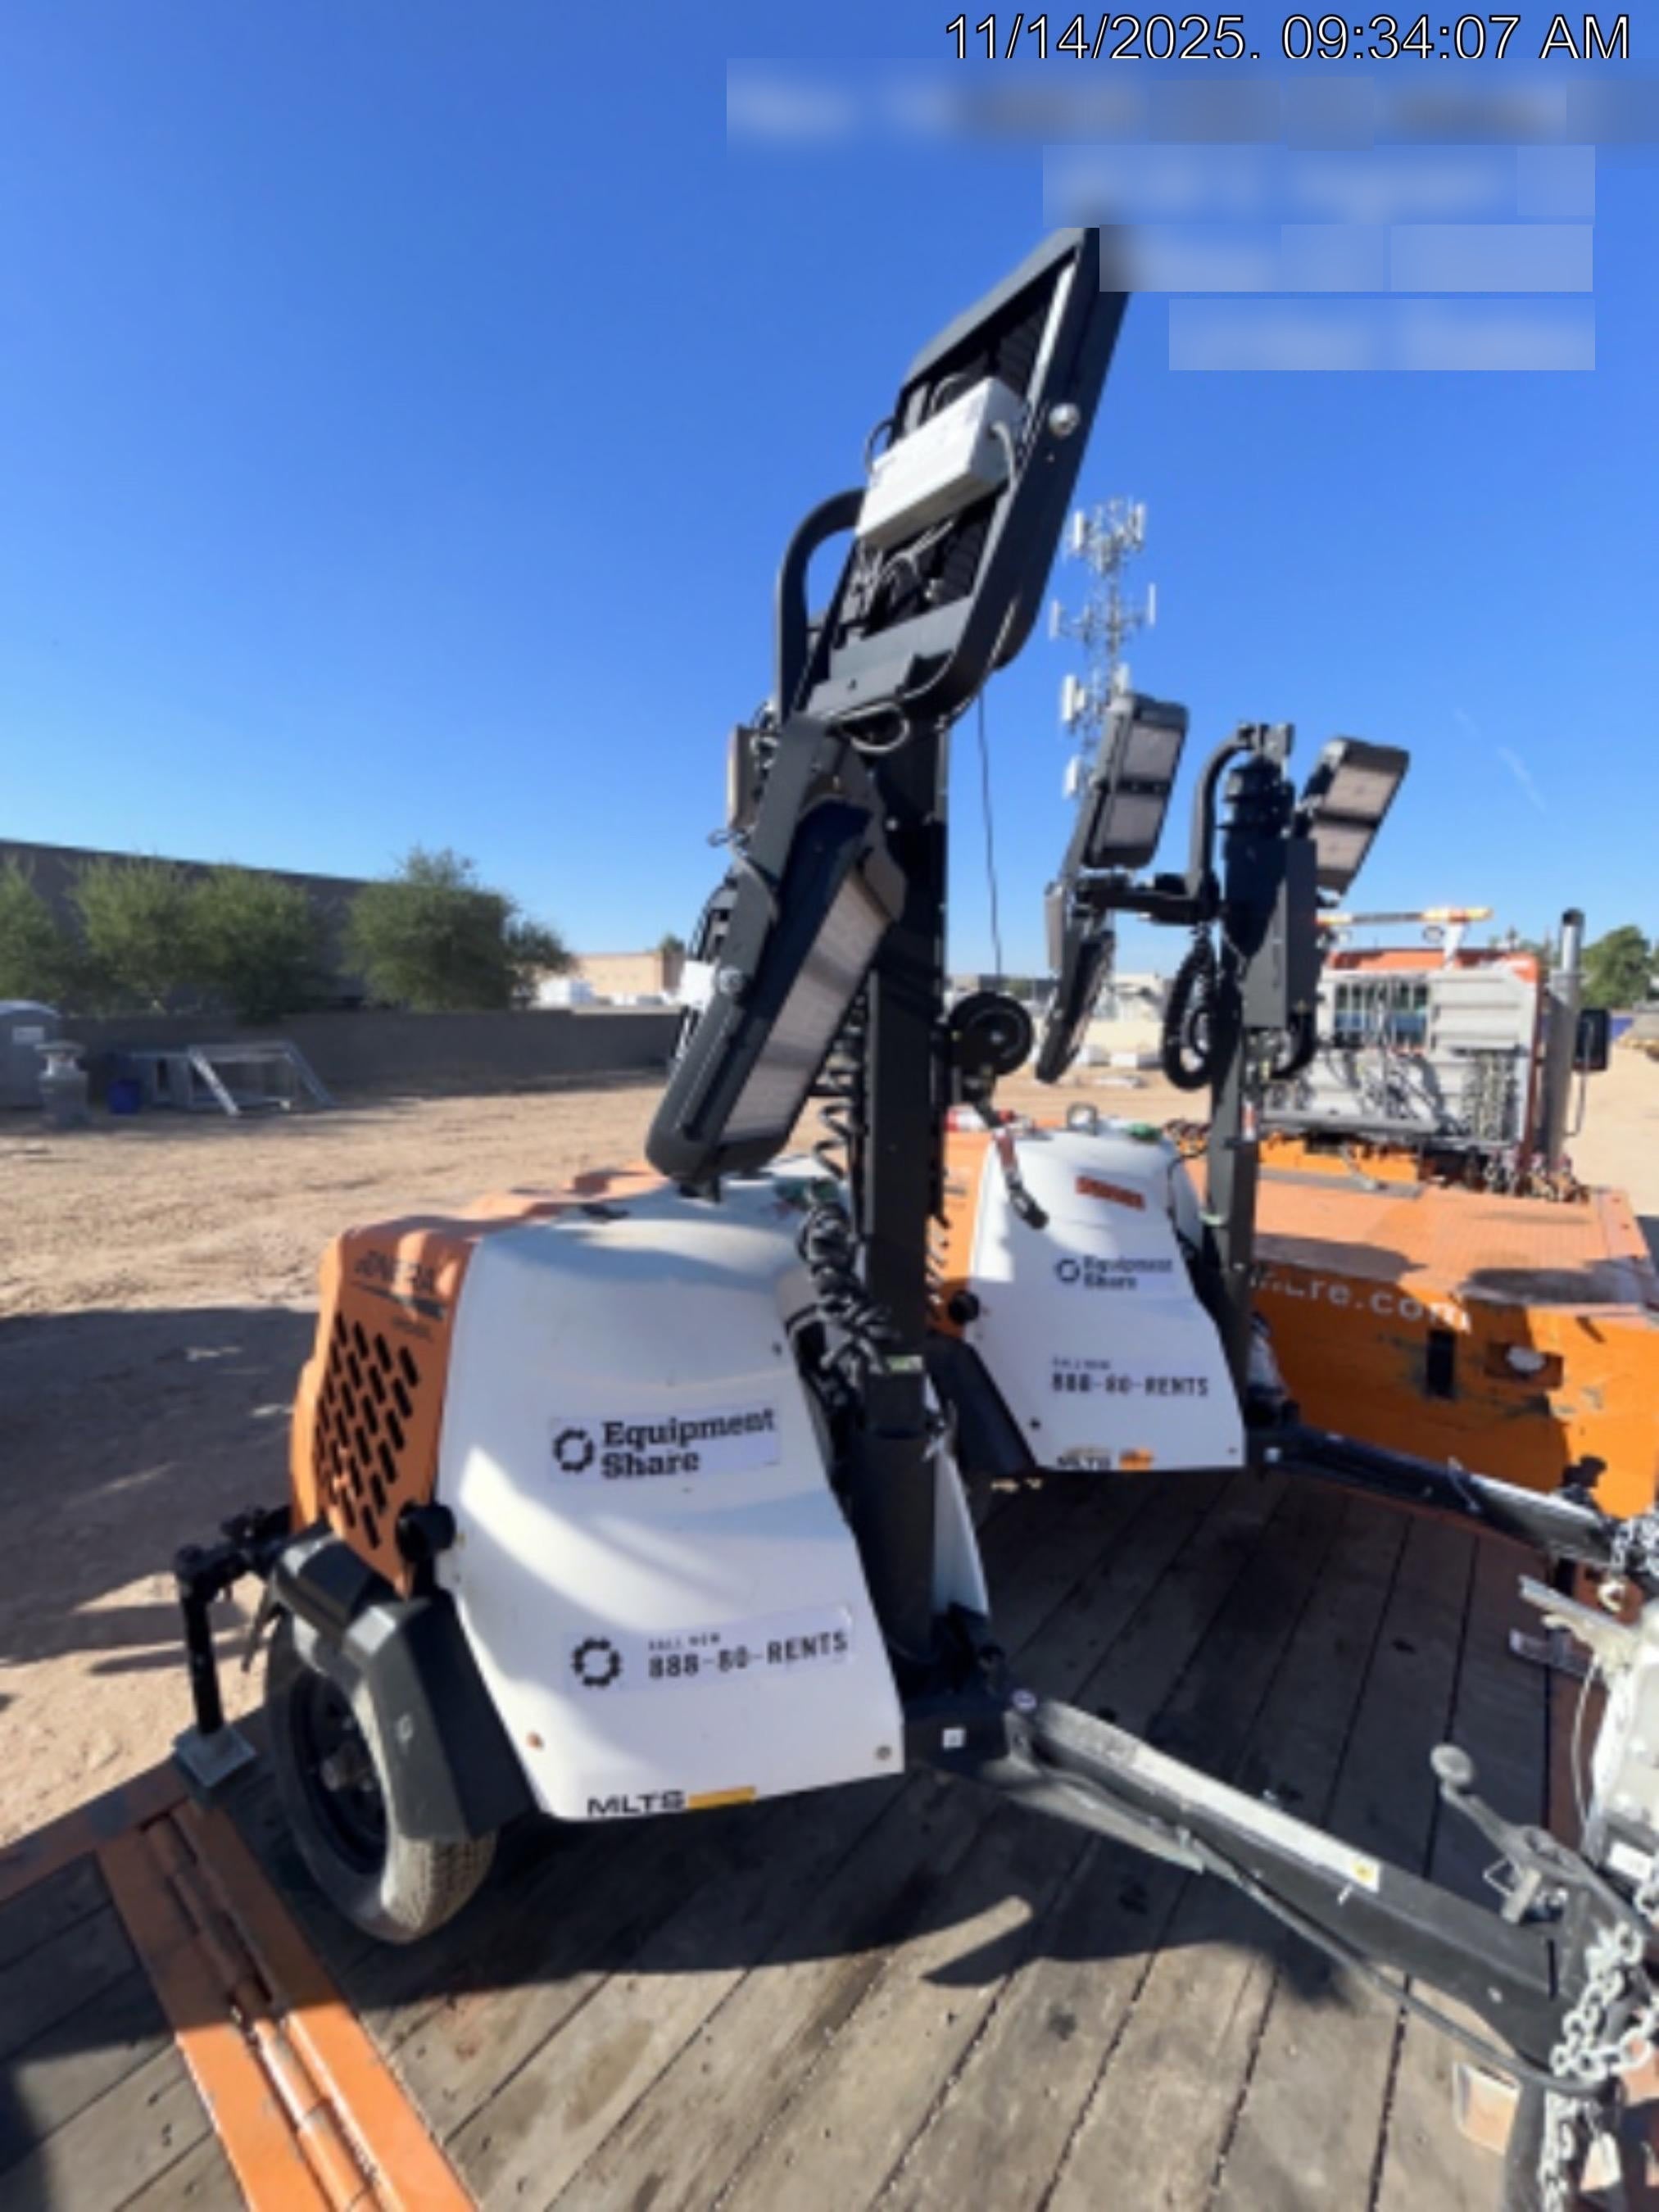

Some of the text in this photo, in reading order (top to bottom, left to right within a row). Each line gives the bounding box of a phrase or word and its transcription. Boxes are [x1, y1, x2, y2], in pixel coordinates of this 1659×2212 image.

[602, 1407, 774, 1452] Equipment
[601, 1451, 700, 1480] Share
[649, 1628, 849, 1679] 888-80-RENTS
